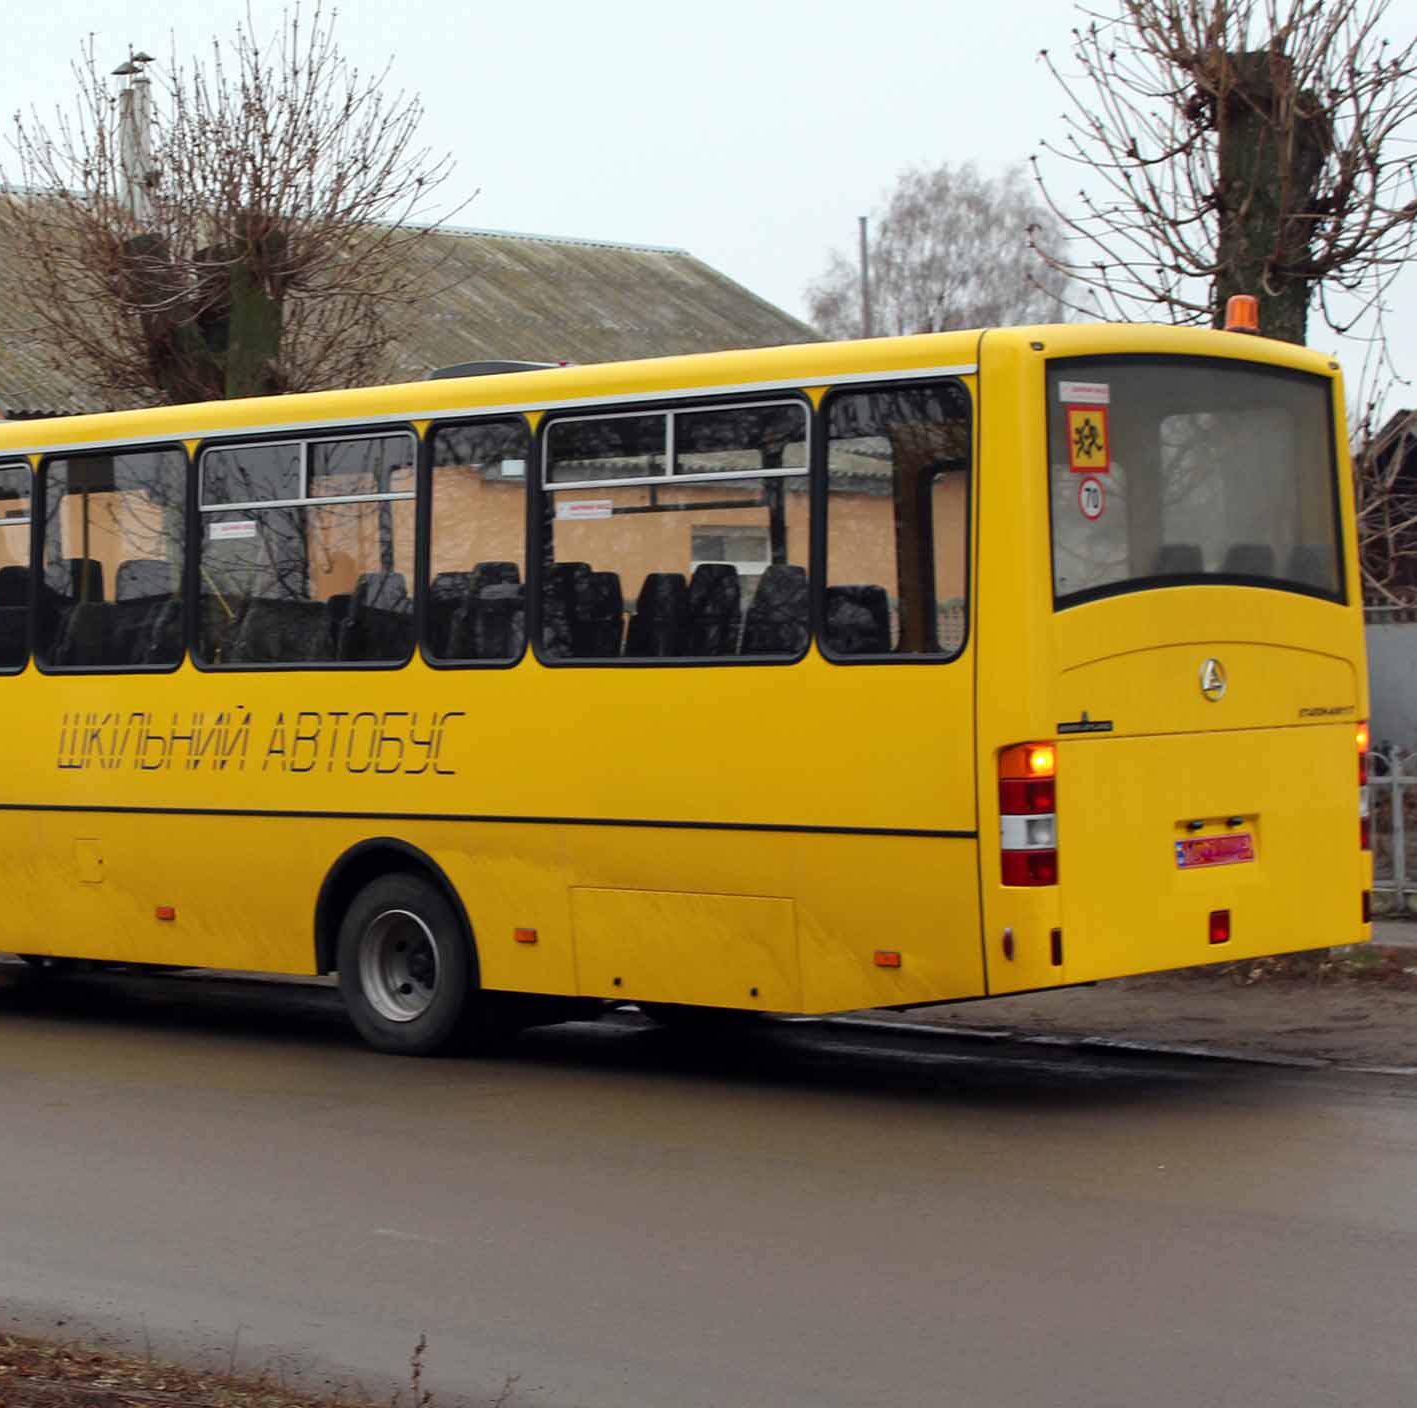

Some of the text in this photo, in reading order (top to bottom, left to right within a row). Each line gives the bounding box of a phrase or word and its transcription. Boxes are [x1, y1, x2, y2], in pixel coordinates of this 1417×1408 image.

[1084, 487, 1099, 509] 70
[57, 705, 466, 775] ШКІЛЬНИЙ АВТОБУС
